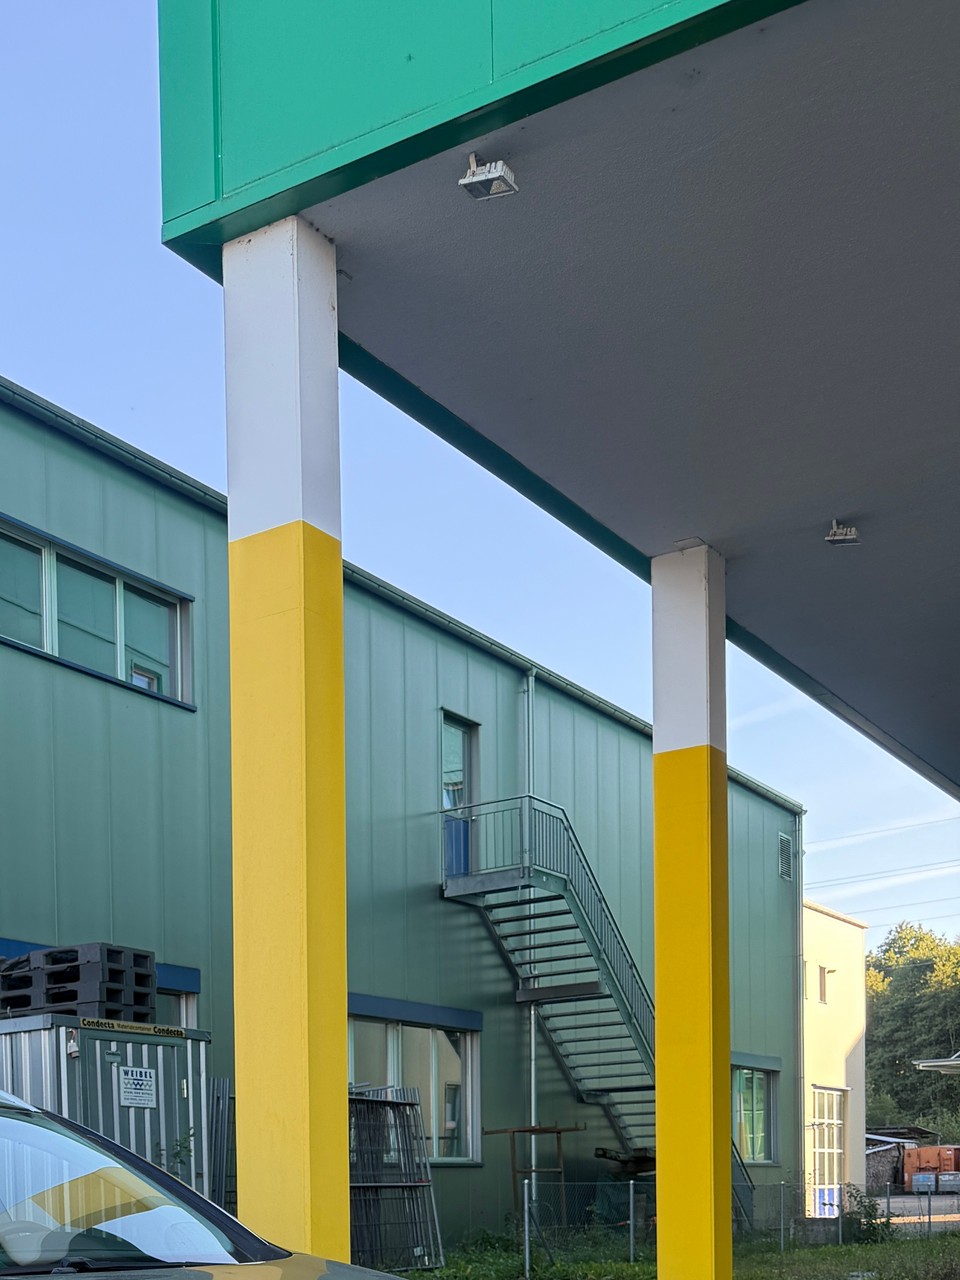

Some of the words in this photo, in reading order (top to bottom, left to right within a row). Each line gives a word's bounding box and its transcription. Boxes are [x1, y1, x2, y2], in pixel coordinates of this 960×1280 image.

[82, 1018, 115, 1029] Condecta
[153, 1026, 184, 1037] Condecta
[123, 1069, 152, 1079] WEIBEL
